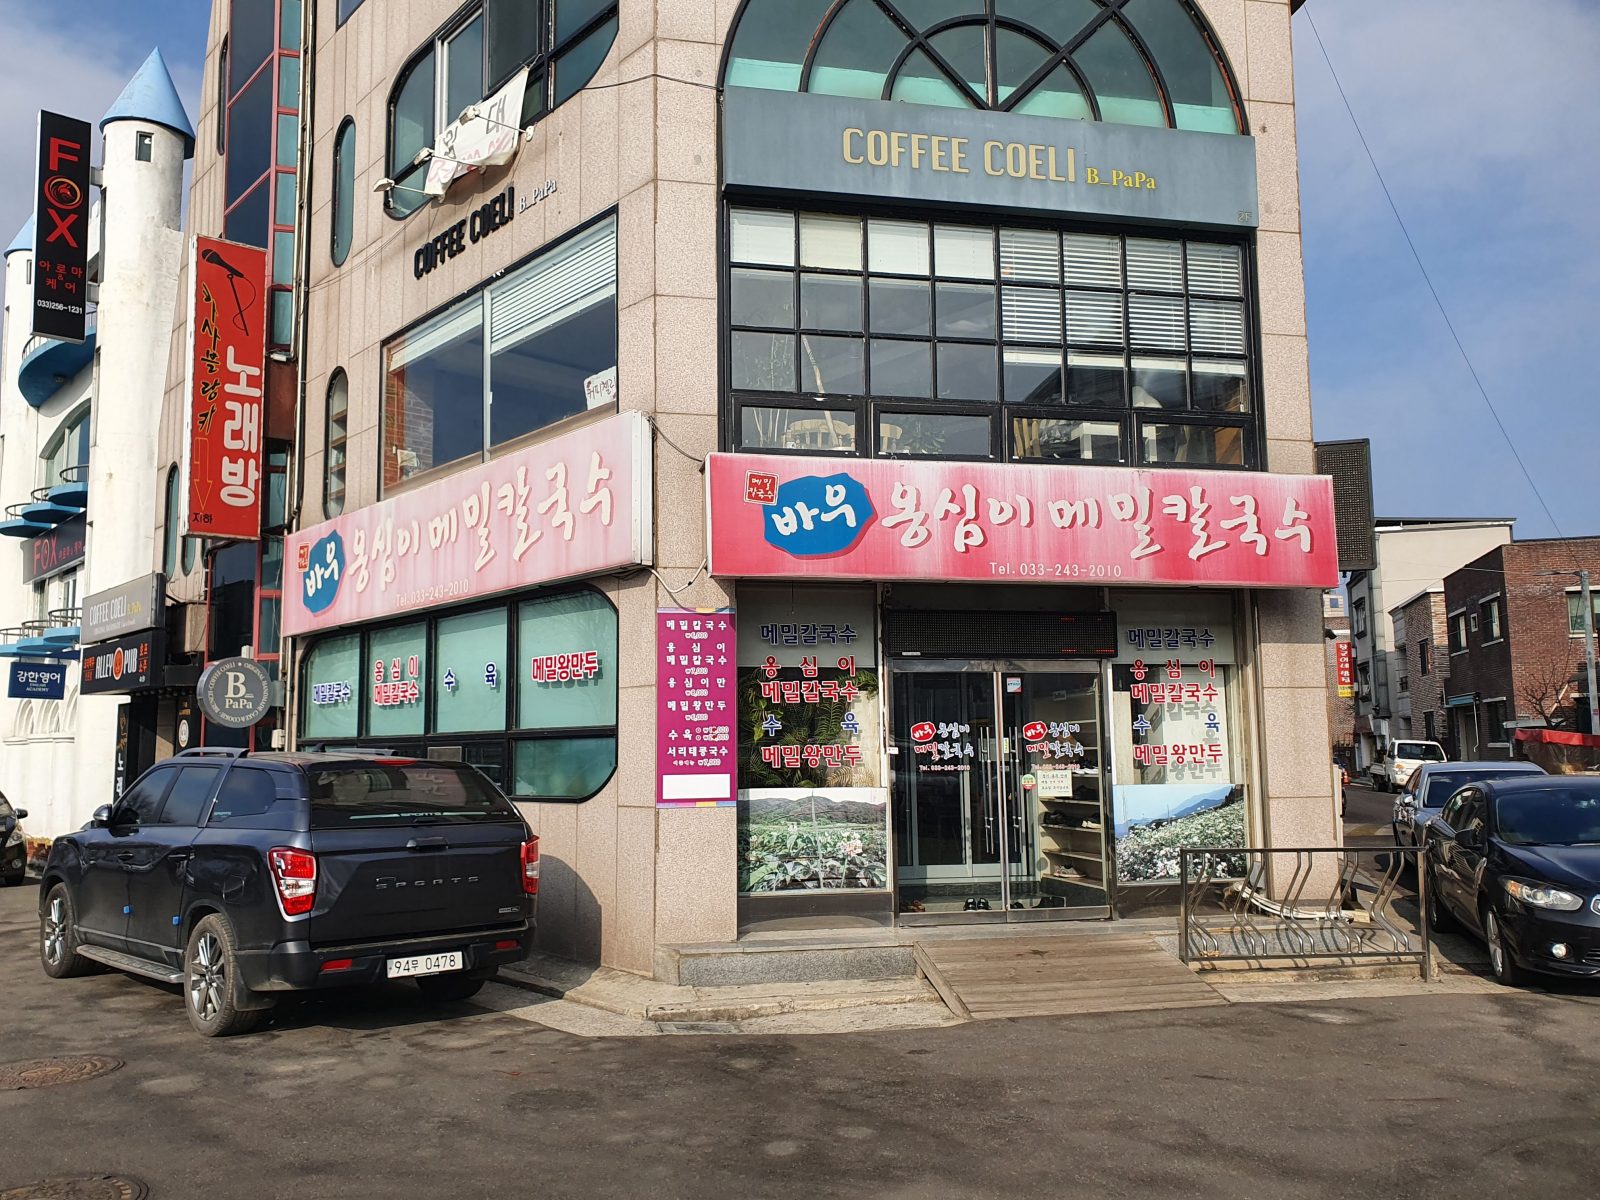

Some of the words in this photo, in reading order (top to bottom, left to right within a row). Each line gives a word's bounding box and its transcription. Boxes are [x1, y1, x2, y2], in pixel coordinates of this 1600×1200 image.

[842, 127, 970, 173] COFFEE
[984, 140, 1076, 182] COELI
[44, 136, 84, 249] FOX
[413, 218, 466, 280] COFFEE
[469, 186, 515, 243] COELI
[39, 259, 83, 279] 아로마
[45, 277, 77, 294] 케어
[37, 299, 83, 315] 033)256-1231
[198, 283, 221, 434] 카사블랑카
[220, 346, 261, 508] 노래방
[751, 477, 772, 491] 메밀
[192, 512, 213, 525] 지하
[428, 451, 612, 572] 메밀칼국수
[771, 484, 857, 536] 바우
[1048, 485, 1312, 560] 메밀칼국수
[33, 534, 57, 577] FOX
[306, 541, 339, 597] 바우
[1019, 562, 1122, 577] 033-243-2010
[90, 600, 109, 627] COFFEE
[760, 623, 857, 645] 메밀칼국수
[1128, 628, 1215, 649] 메밀칼국수
[95, 653, 114, 680] ALLEY
[123, 648, 138, 674] PUB
[374, 654, 419, 684] 옹심이
[531, 650, 599, 683] 메밀왕만두
[761, 655, 856, 678] 옹심이
[1130, 659, 1216, 680] 옹심이
[17, 671, 61, 684] 강한영어
[225, 698, 253, 709] PaPa
[312, 680, 351, 706] 메밀칼국수
[373, 679, 419, 707] 메밀칼국수
[761, 681, 859, 703] 메밀칼국수
[1130, 683, 1219, 705] 메밀칼국수
[668, 728, 693, 741] 수육
[761, 745, 862, 768] 메밀왕만두
[1134, 744, 1223, 765] 메밀왕만두
[394, 959, 419, 974] 94무
[425, 954, 456, 971] 0478
